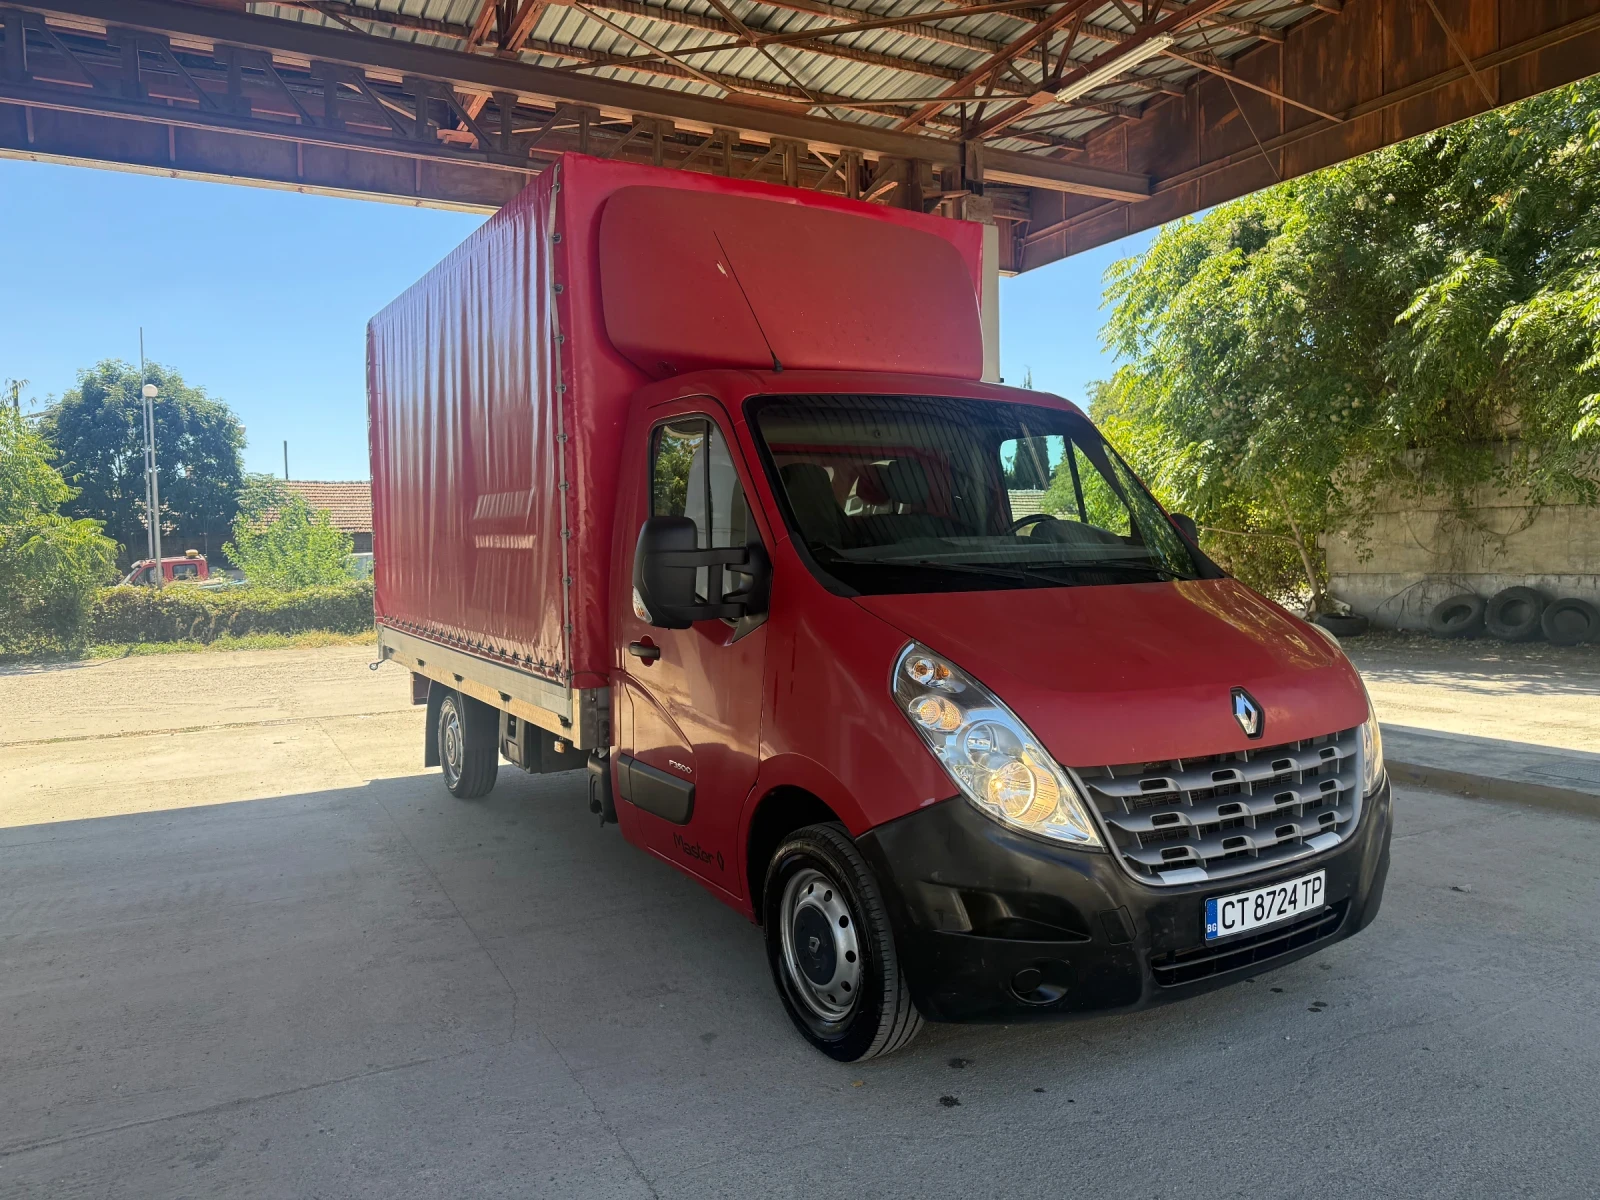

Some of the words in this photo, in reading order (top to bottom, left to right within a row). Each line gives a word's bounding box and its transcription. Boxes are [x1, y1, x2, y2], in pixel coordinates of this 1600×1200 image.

[668, 759, 693, 774] F3500
[673, 832, 714, 864] Master
[1222, 897, 1249, 929] CT
[1254, 884, 1297, 921] 8724
[1302, 876, 1322, 906] TP
[1207, 922, 1217, 933] BG
